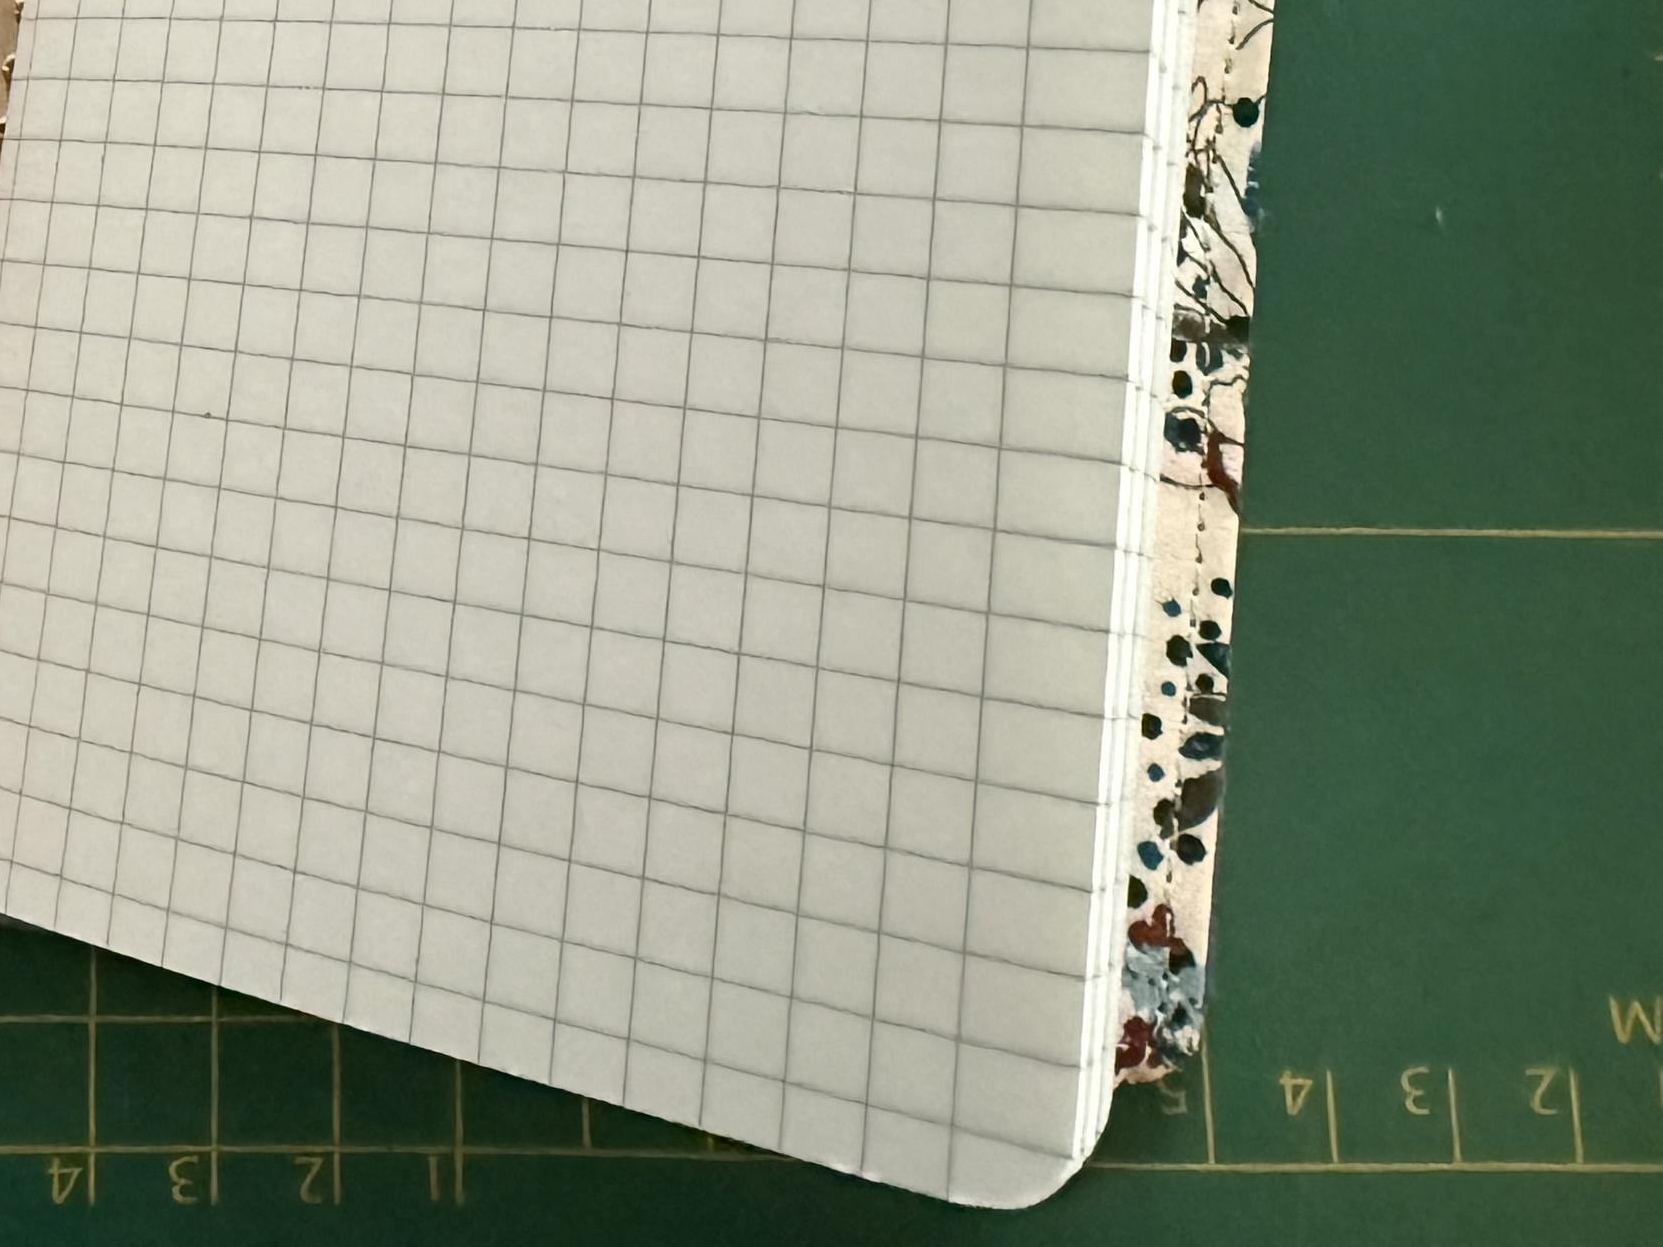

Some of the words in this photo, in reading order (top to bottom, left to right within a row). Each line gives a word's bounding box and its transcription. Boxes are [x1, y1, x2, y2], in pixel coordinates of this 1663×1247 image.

[1278, 1069, 1314, 1116] 4
[1399, 1065, 1431, 1116] 3
[1524, 1066, 1560, 1117] 2
[46, 1157, 82, 1205] 4
[168, 1156, 199, 1204] 3
[294, 1156, 324, 1204] 2
